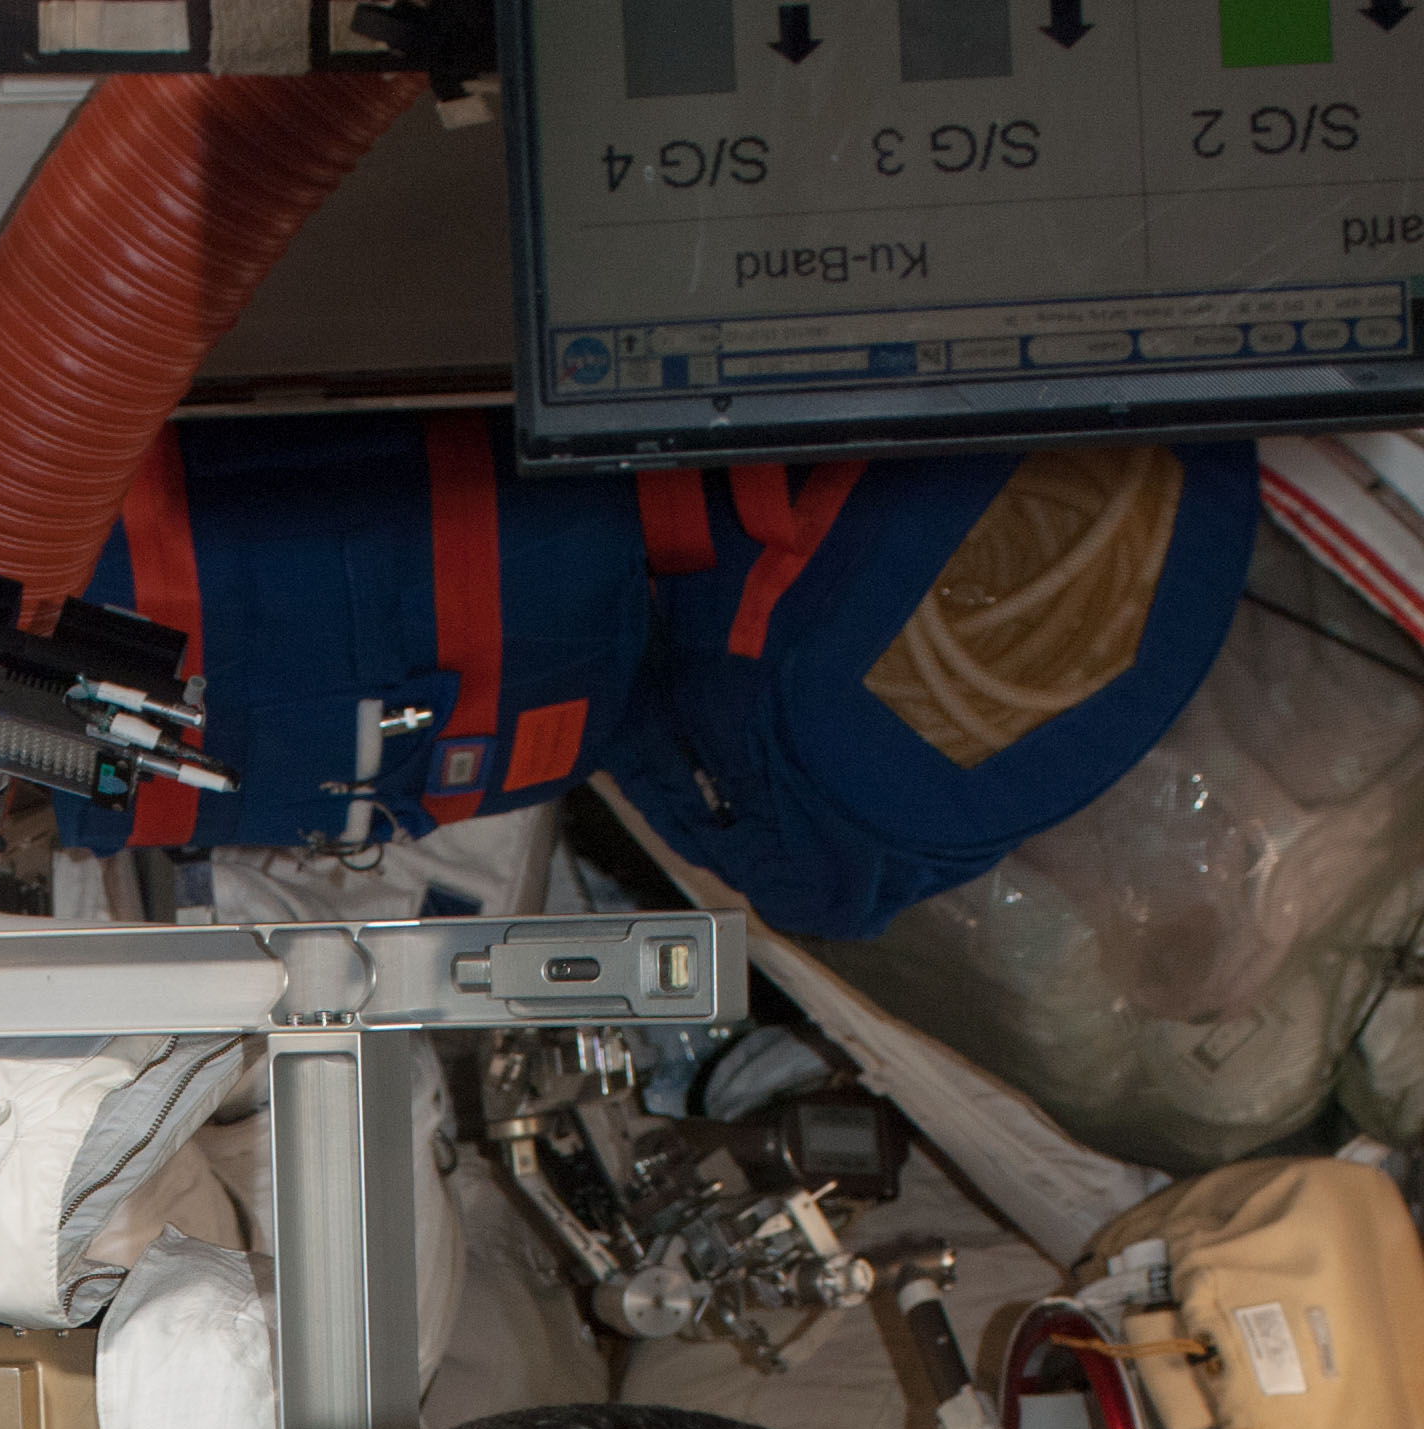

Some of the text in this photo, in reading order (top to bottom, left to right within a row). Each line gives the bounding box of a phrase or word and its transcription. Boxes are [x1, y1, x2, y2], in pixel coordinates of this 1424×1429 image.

[872, 120, 1042, 176] S/G 3
[1191, 102, 1362, 158] S/G 2
[601, 135, 771, 194] S/G 4
[734, 241, 929, 288] Ku-Band
